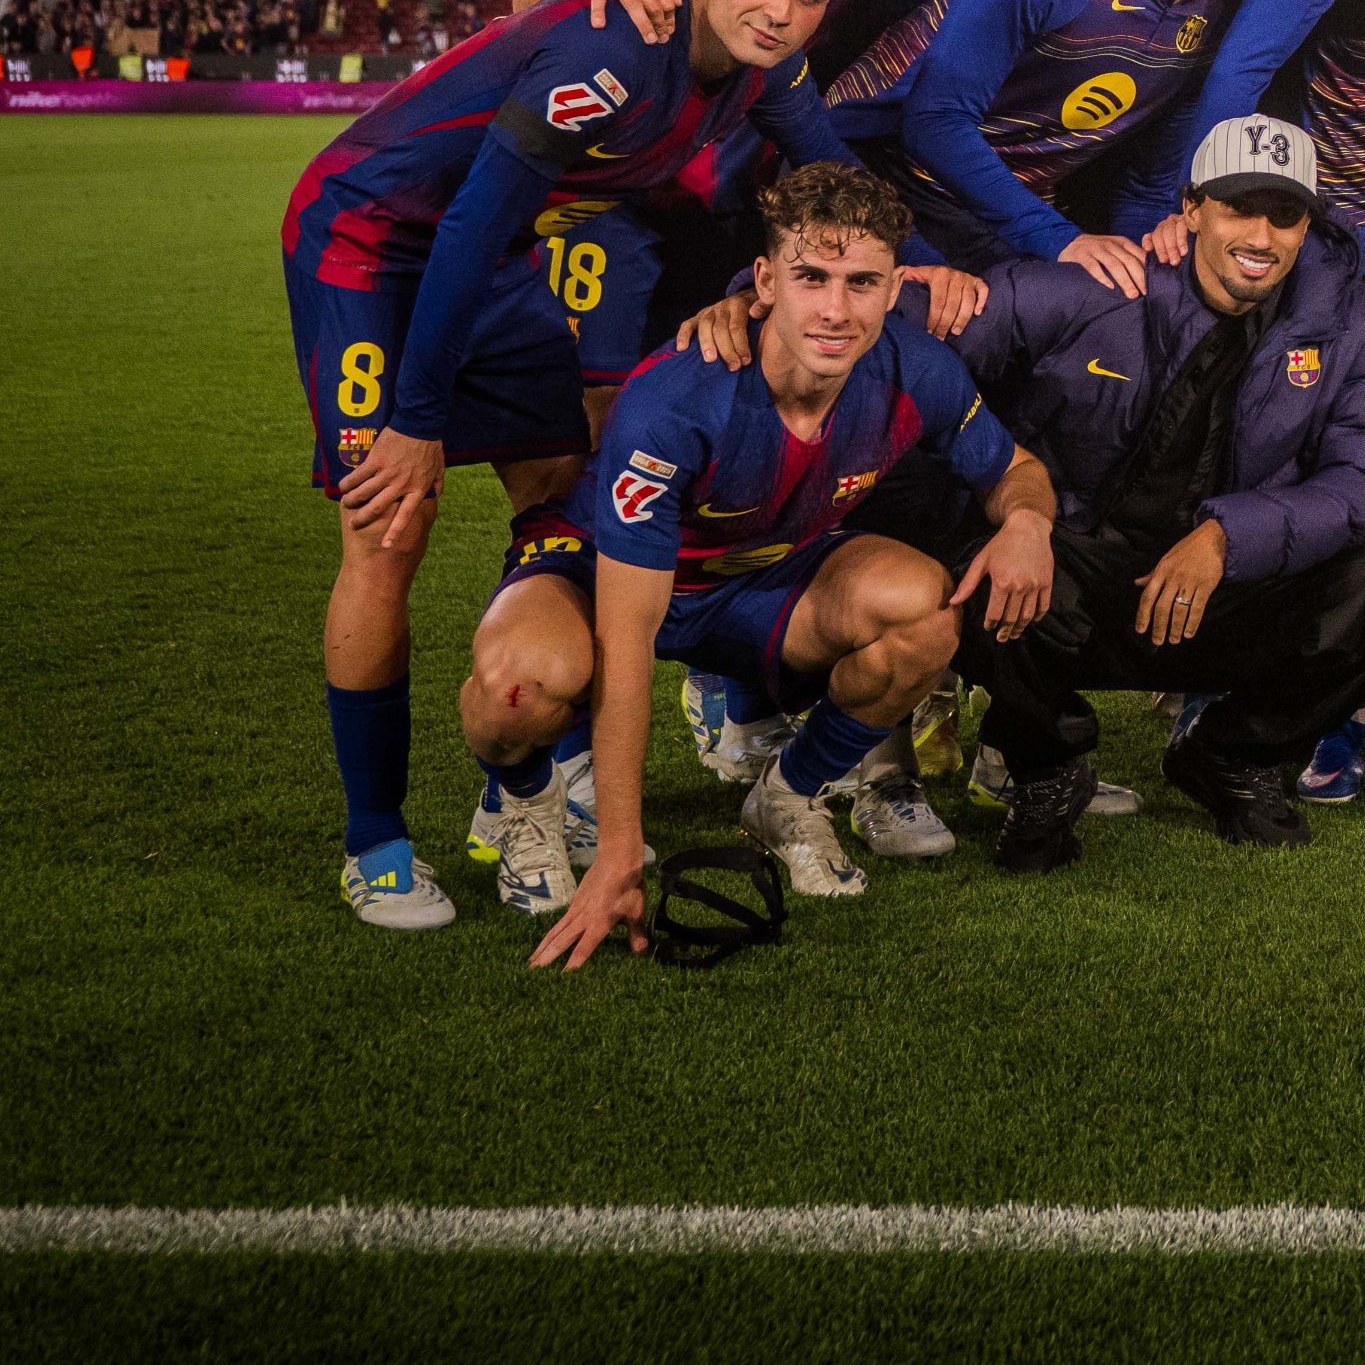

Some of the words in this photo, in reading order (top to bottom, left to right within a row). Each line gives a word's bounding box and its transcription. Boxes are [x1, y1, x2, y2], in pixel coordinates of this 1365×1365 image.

[1244, 124, 1290, 167] Y-3
[546, 236, 606, 311] 18
[338, 341, 385, 418] 8
